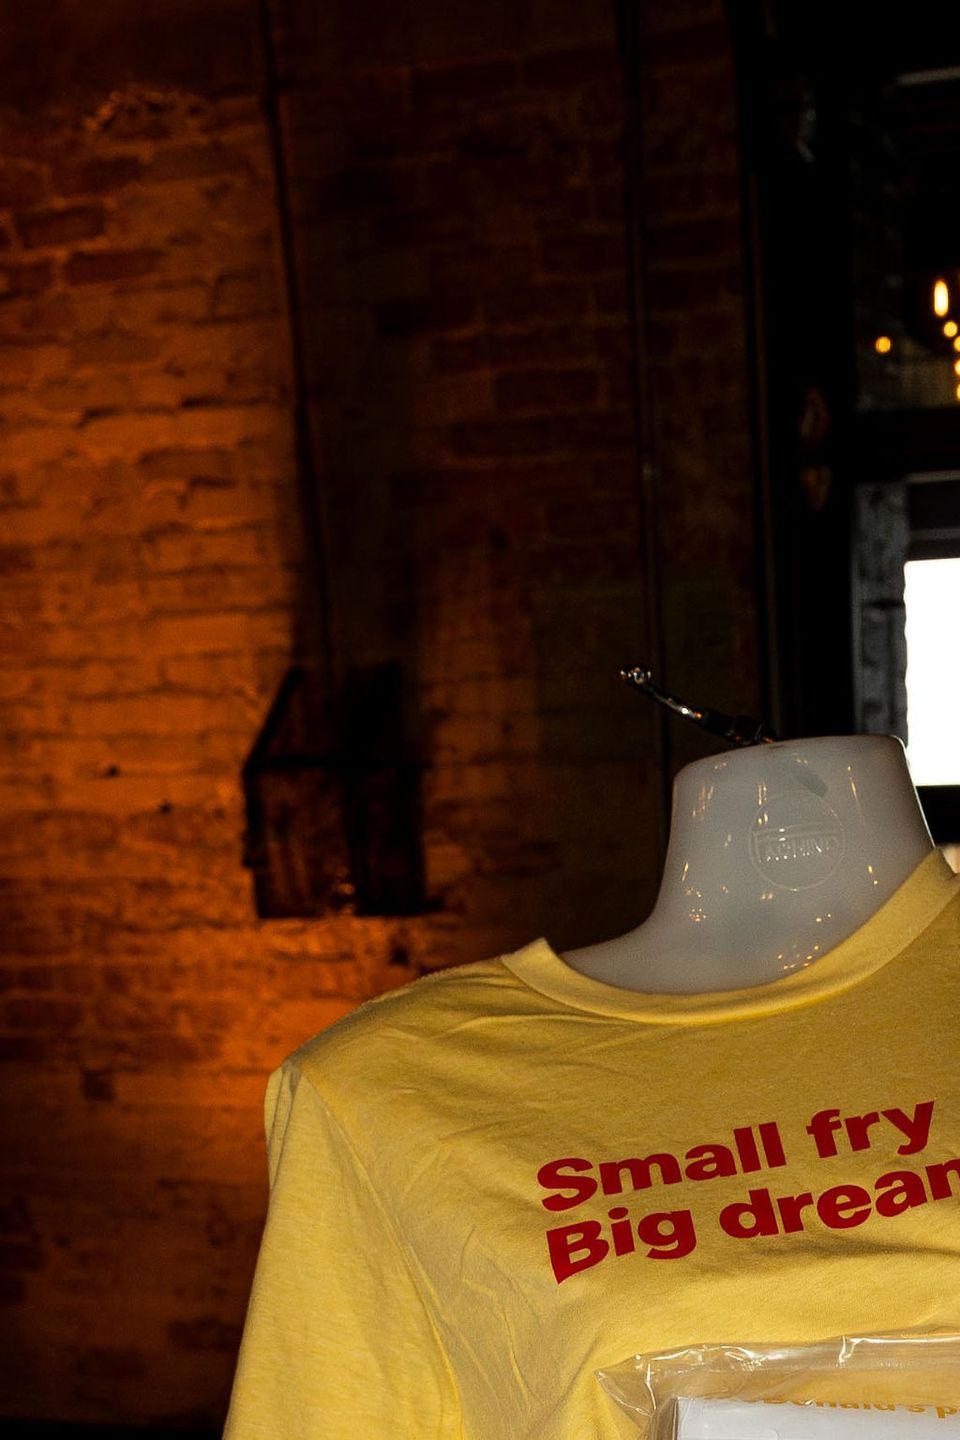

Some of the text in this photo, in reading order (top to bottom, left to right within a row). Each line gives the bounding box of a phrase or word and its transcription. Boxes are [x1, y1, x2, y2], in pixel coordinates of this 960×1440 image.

[537, 1100, 935, 1212] Small fry
[546, 1206, 697, 1284] Big
